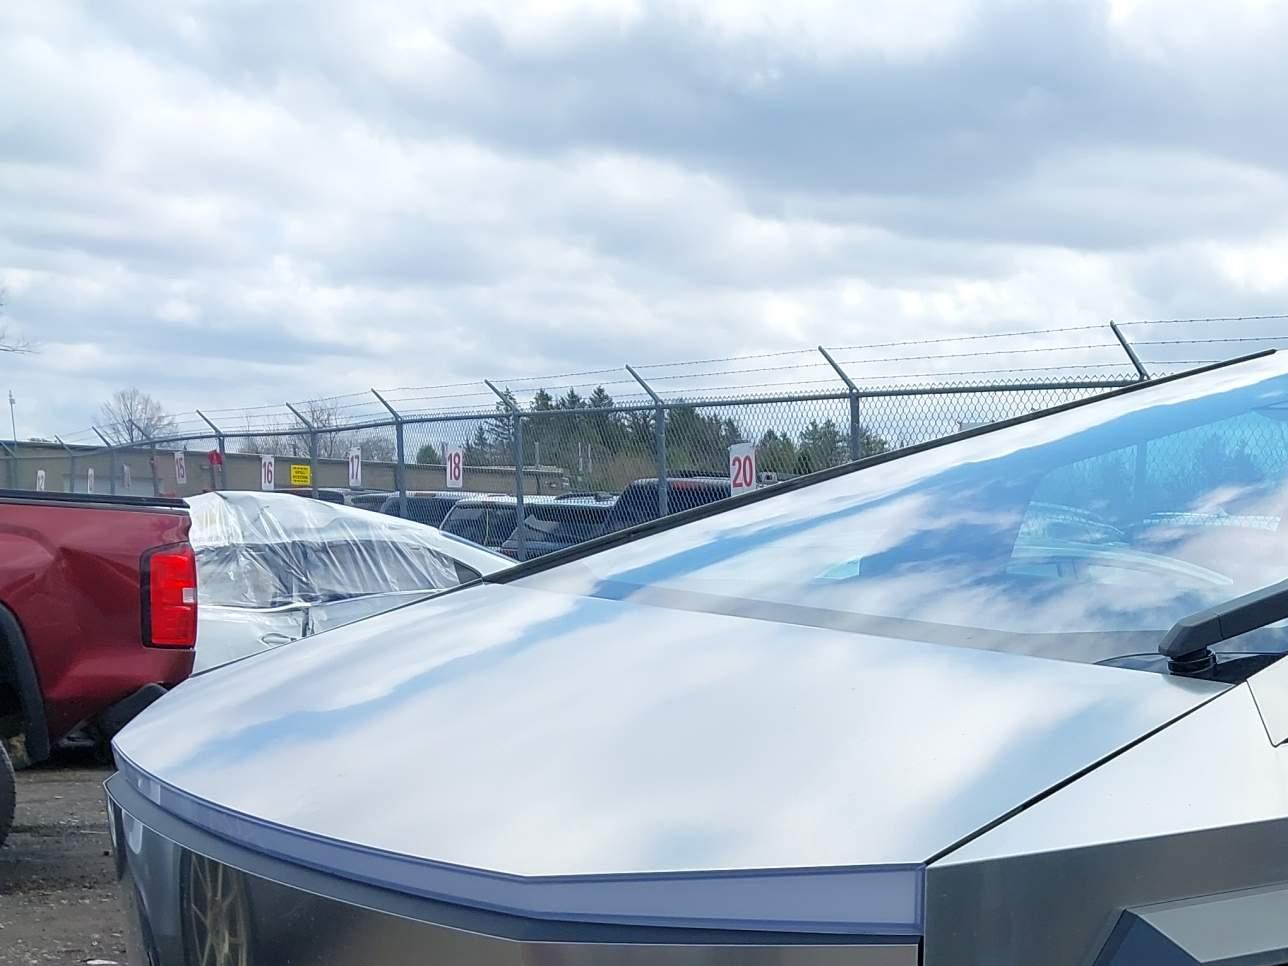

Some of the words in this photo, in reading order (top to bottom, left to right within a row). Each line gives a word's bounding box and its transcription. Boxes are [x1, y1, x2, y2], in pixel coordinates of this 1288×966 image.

[263, 461, 273, 484] 16
[350, 455, 360, 480] 17
[447, 452, 461, 481] 18
[732, 455, 754, 488] 20
